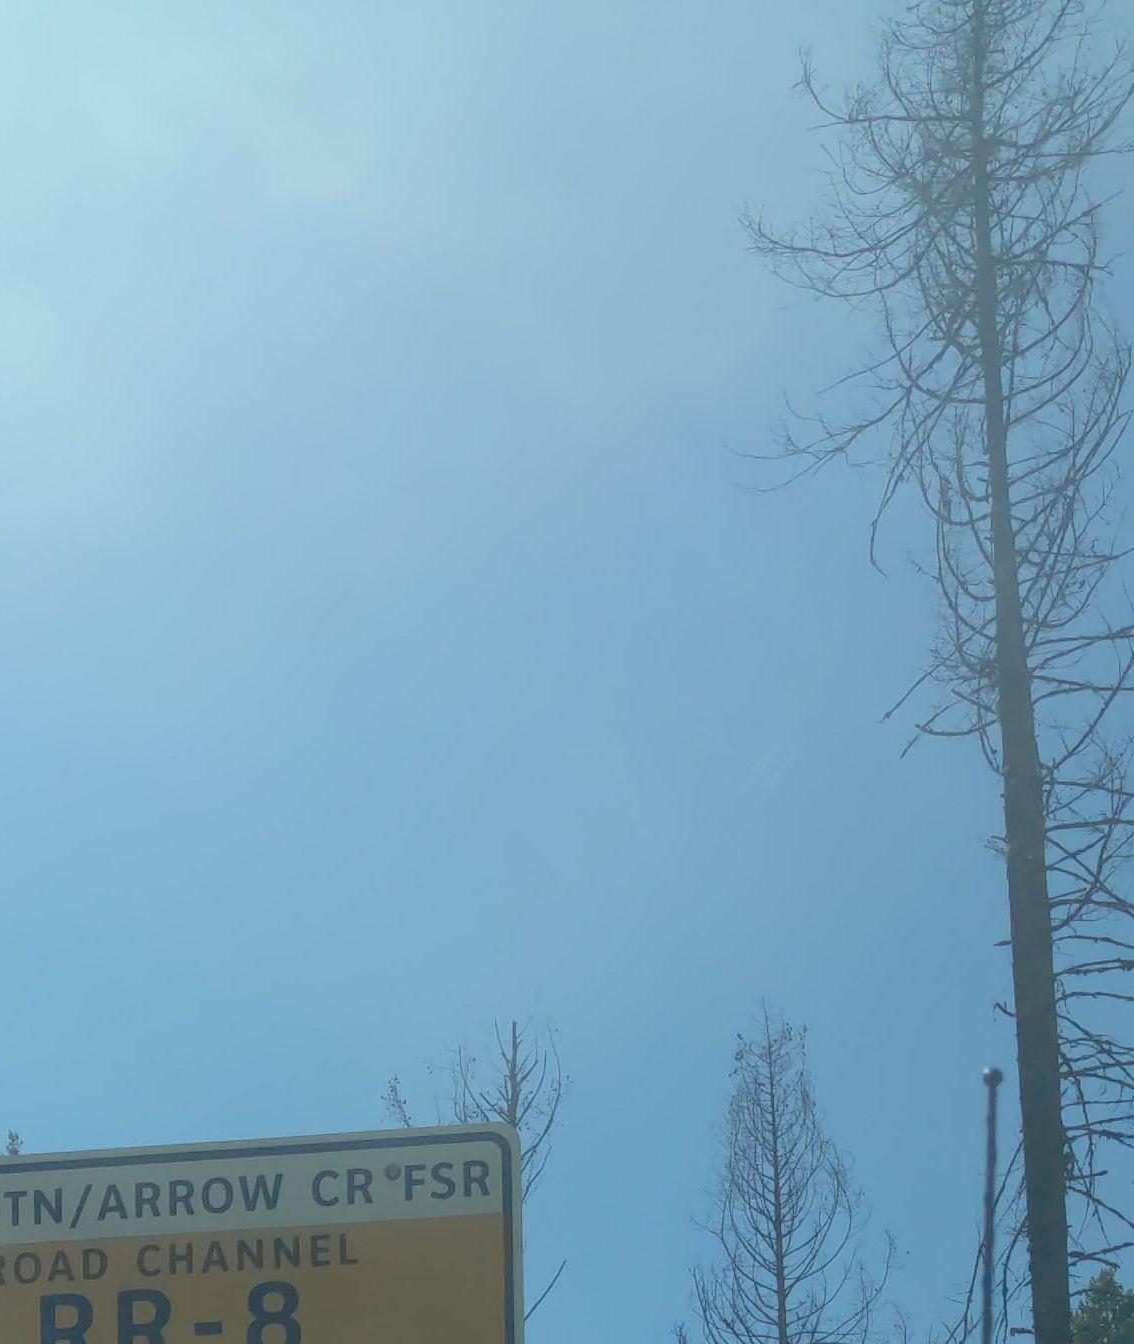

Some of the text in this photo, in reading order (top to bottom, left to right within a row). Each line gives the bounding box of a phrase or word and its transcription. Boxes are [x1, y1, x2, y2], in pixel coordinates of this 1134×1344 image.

[311, 1168, 373, 1207] CR
[404, 1160, 490, 1201] FSR
[137, 1233, 358, 1277] CHANNEL
